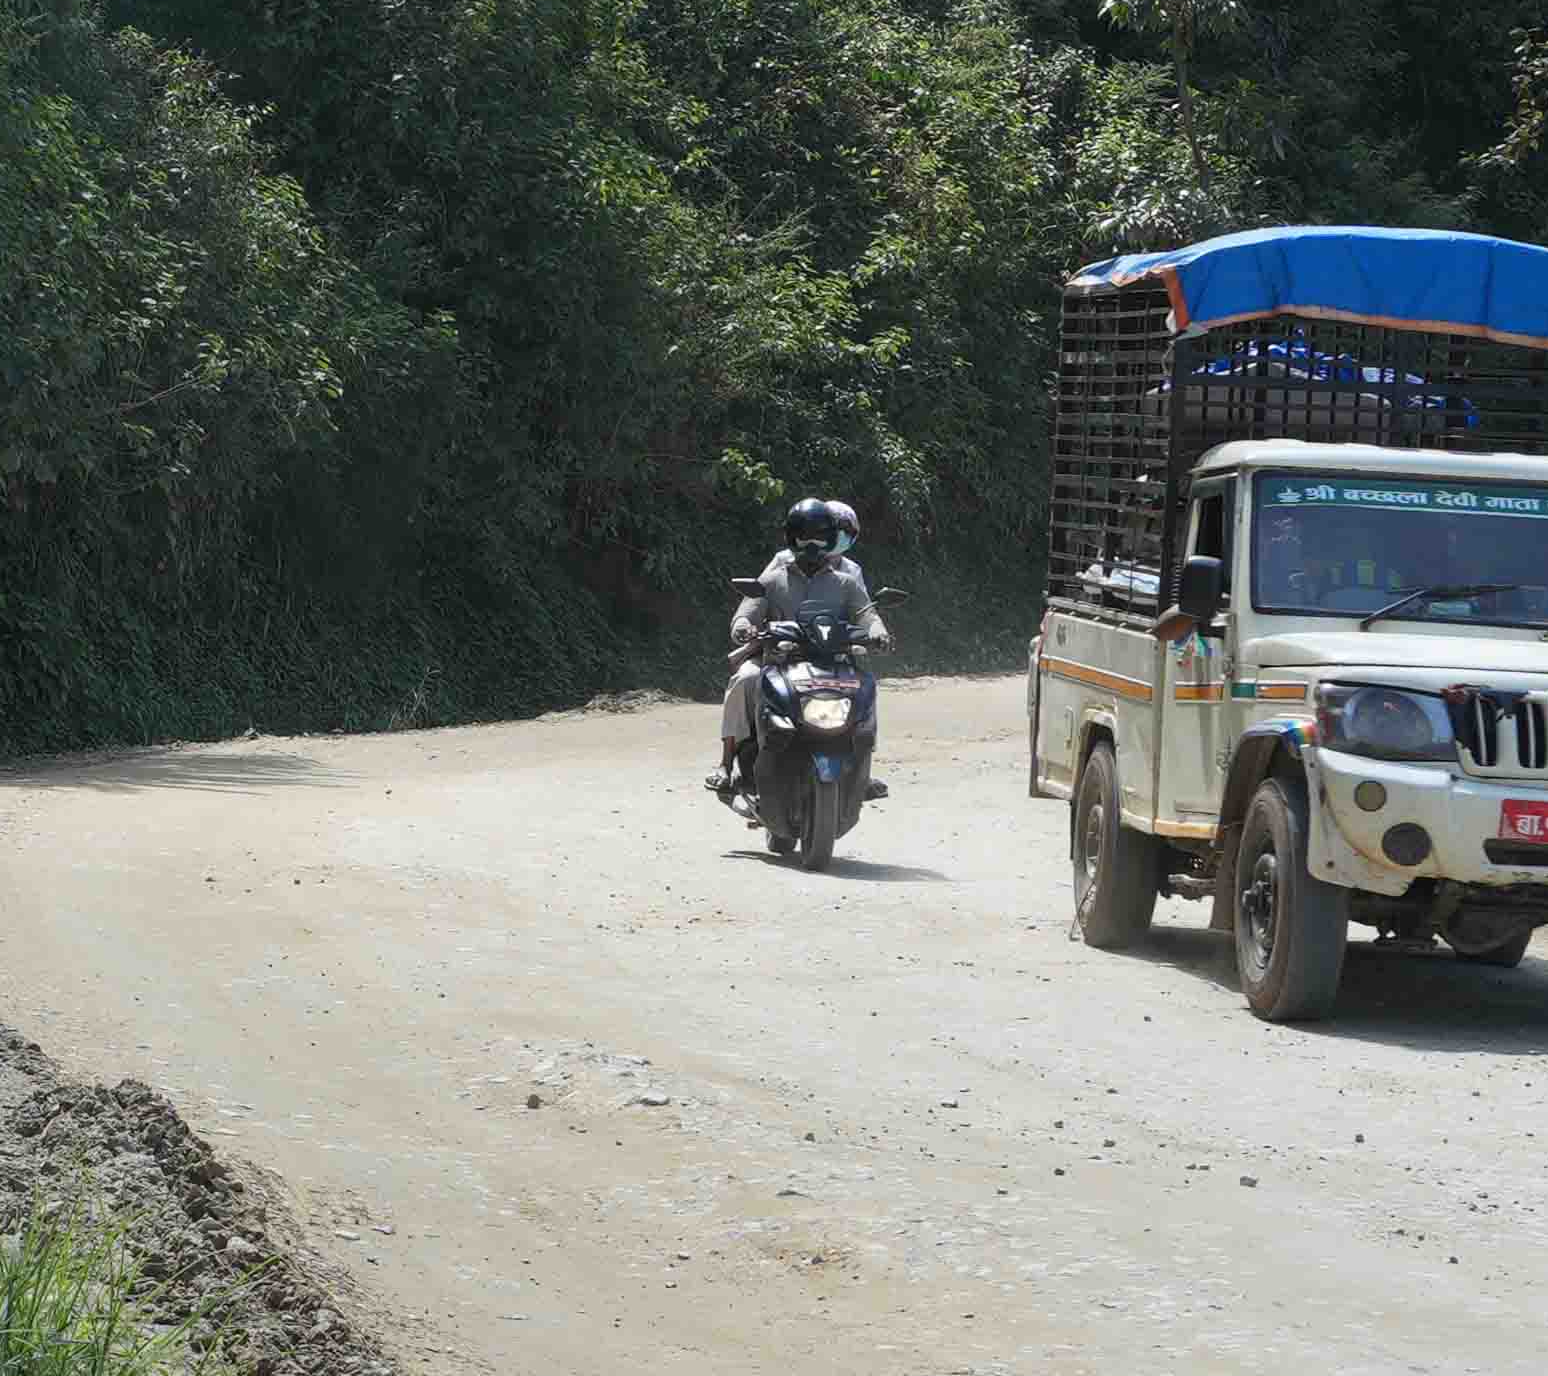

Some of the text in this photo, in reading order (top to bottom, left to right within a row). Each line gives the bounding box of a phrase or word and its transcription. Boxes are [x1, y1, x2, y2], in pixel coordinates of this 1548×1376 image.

[1304, 484, 1337, 501] श्री
[1433, 489, 1479, 508] देवी
[1484, 496, 1540, 511] माता
